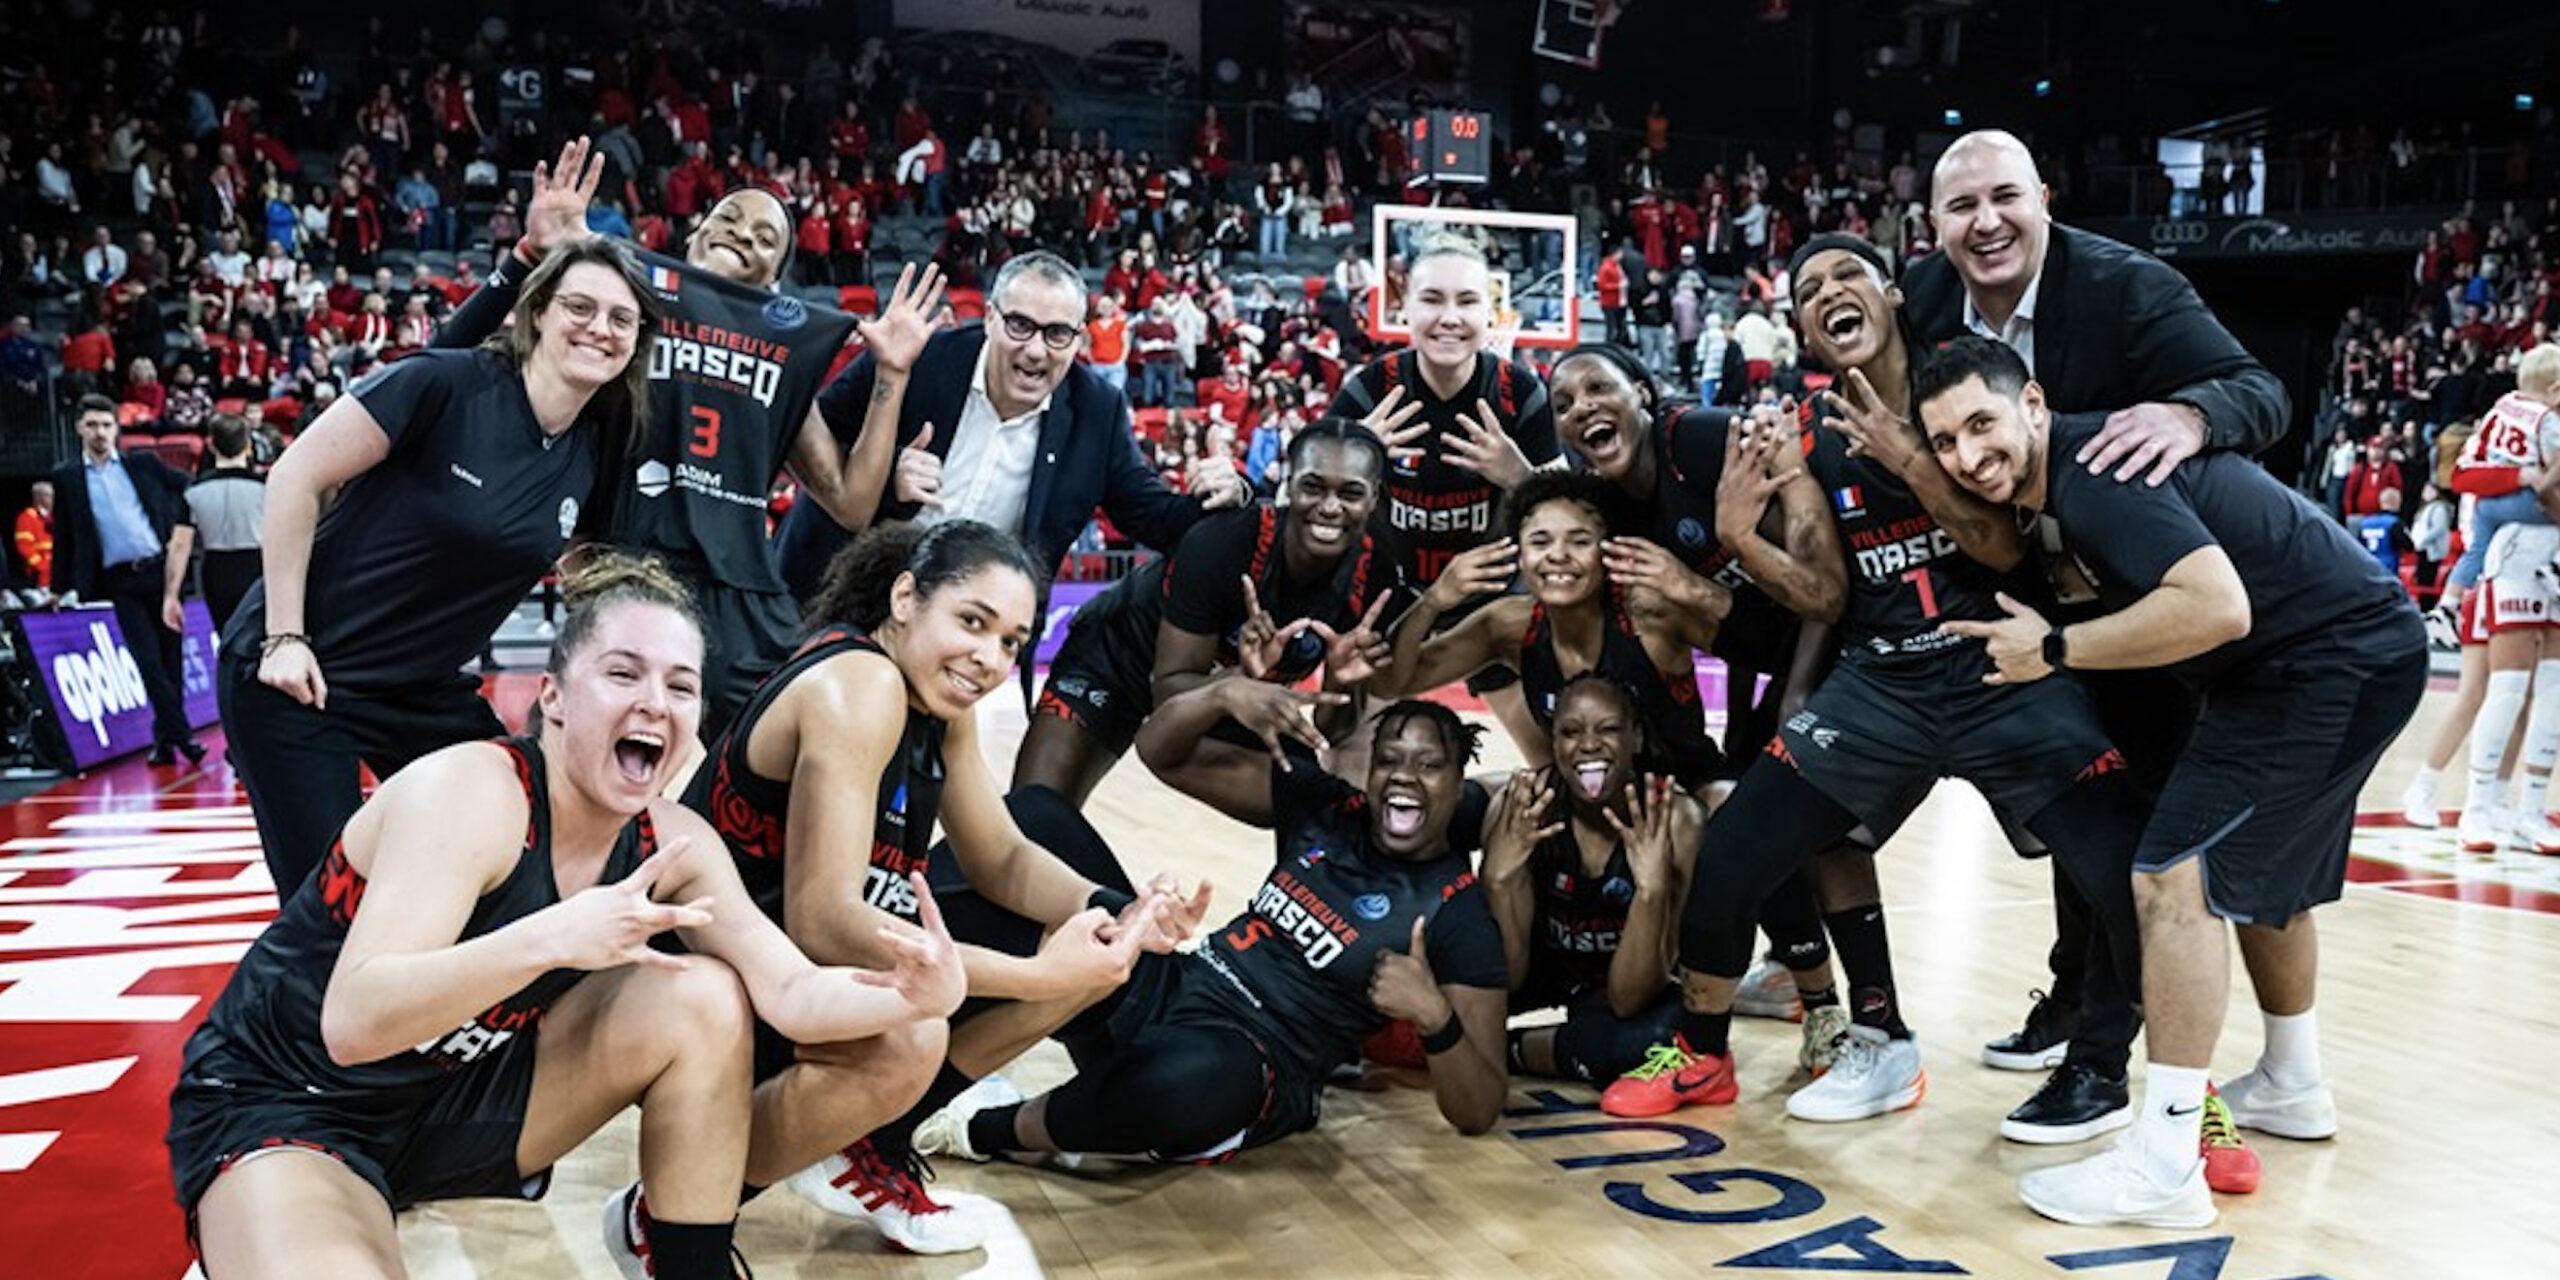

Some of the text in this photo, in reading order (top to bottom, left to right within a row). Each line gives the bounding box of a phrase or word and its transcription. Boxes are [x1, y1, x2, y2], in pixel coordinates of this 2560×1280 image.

[518, 69, 542, 100] G
[2250, 229, 2363, 252] Miskolc
[661, 316, 791, 364] ILLENEUVE
[647, 335, 783, 408] D'ASCQ
[688, 404, 722, 458] 3
[1856, 528, 1957, 583] D'ASC
[53, 621, 147, 747] apollo
[1226, 917, 1276, 953] 5
